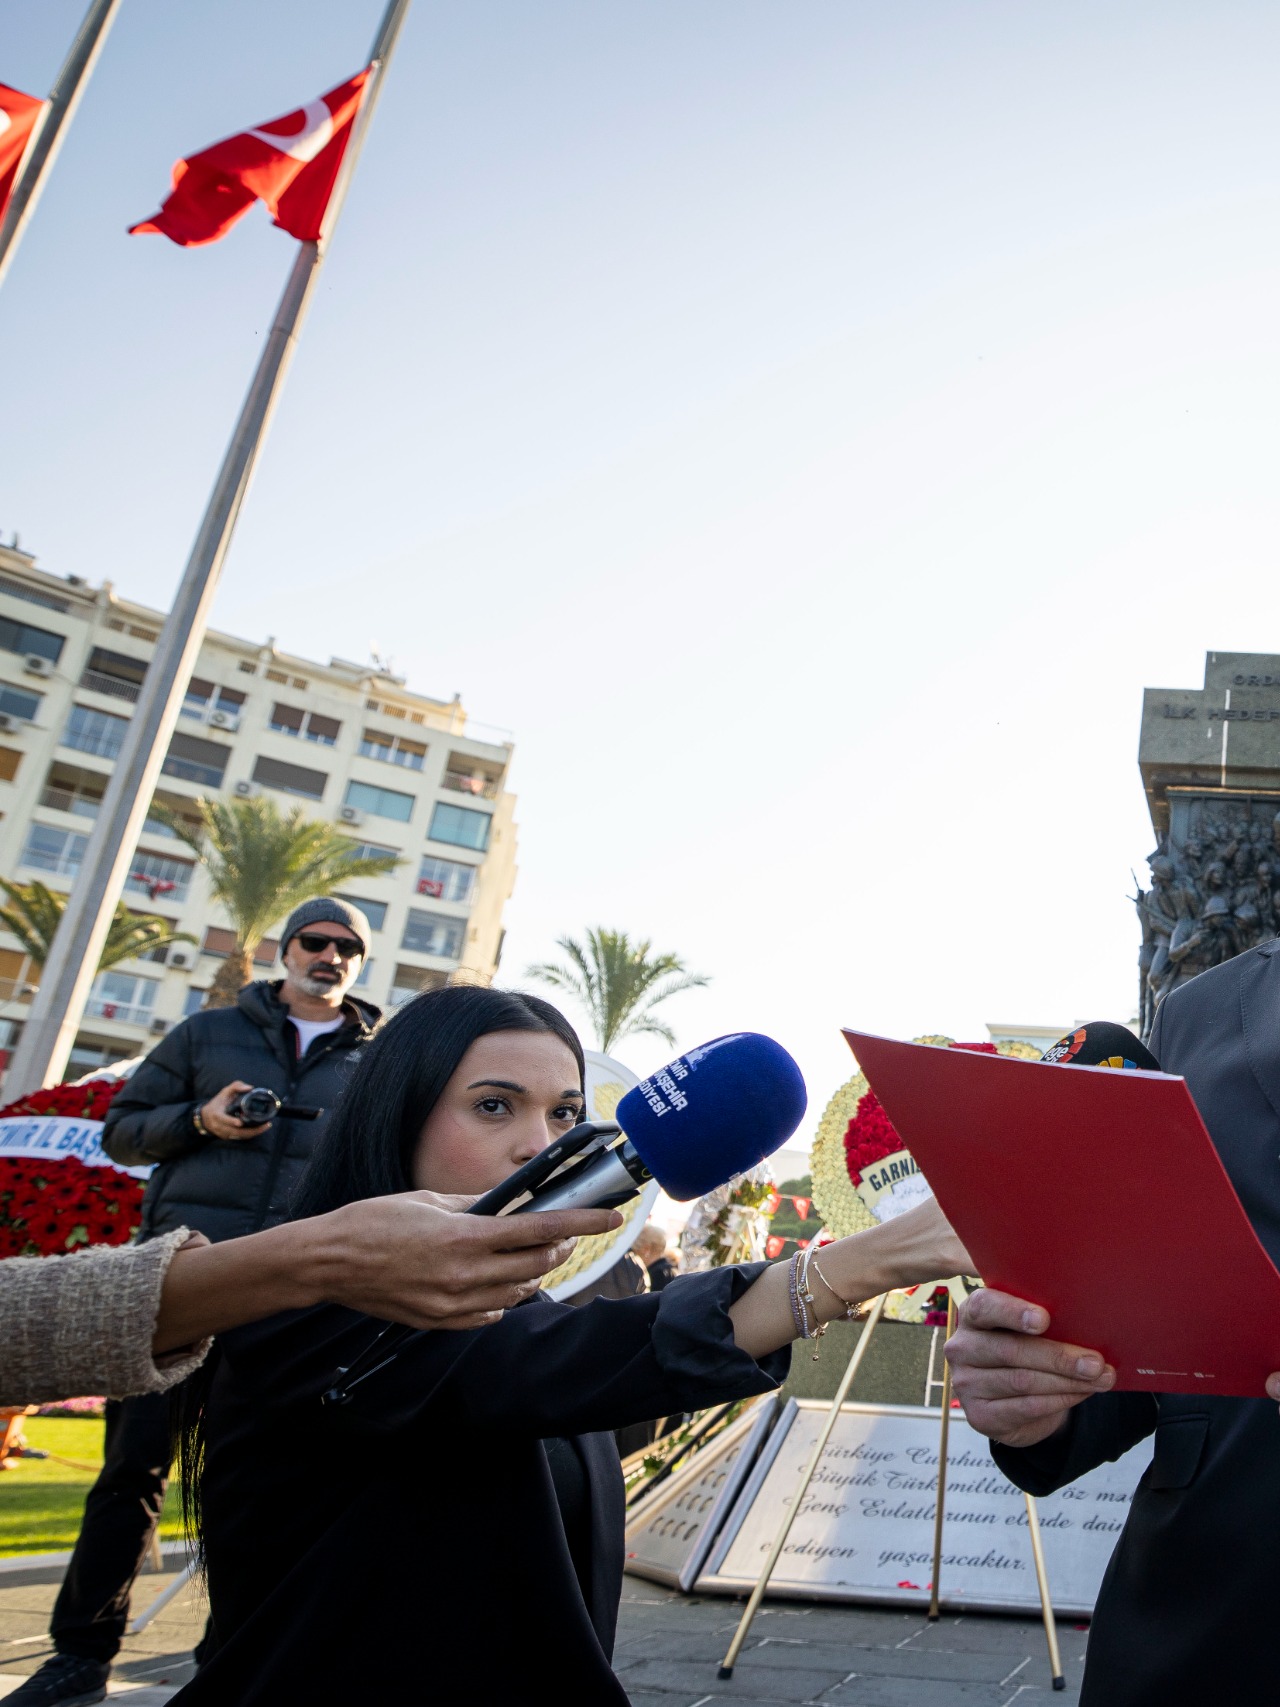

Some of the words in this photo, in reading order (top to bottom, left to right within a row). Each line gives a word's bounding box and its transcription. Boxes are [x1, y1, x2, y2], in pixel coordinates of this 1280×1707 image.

[638, 1079, 672, 1117] EDİYESİ
[57, 1126, 109, 1159] BAŞ
[868, 1157, 921, 1192] GARNI
[883, 1470, 938, 1492] Türk
[1063, 1487, 1087, 1501] öz
[1097, 1491, 1135, 1504] ma
[760, 1538, 857, 1563] eediyen
